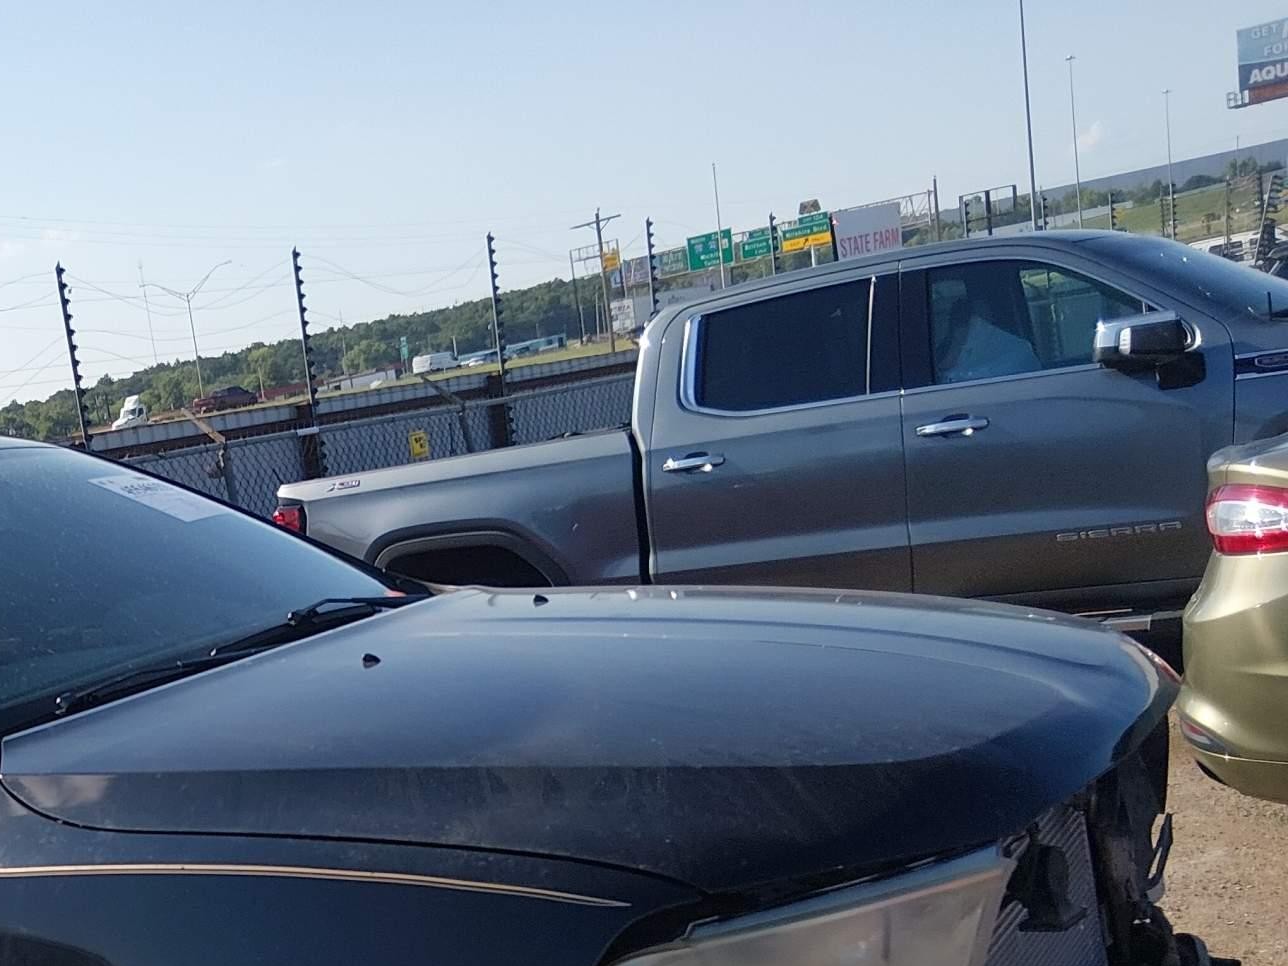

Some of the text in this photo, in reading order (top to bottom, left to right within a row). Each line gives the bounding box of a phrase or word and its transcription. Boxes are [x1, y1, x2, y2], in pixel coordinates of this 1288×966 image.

[1252, 23, 1279, 39] GET
[839, 233, 871, 258] STATE
[874, 227, 899, 249] FARM
[1056, 520, 1183, 542] SIERRA
